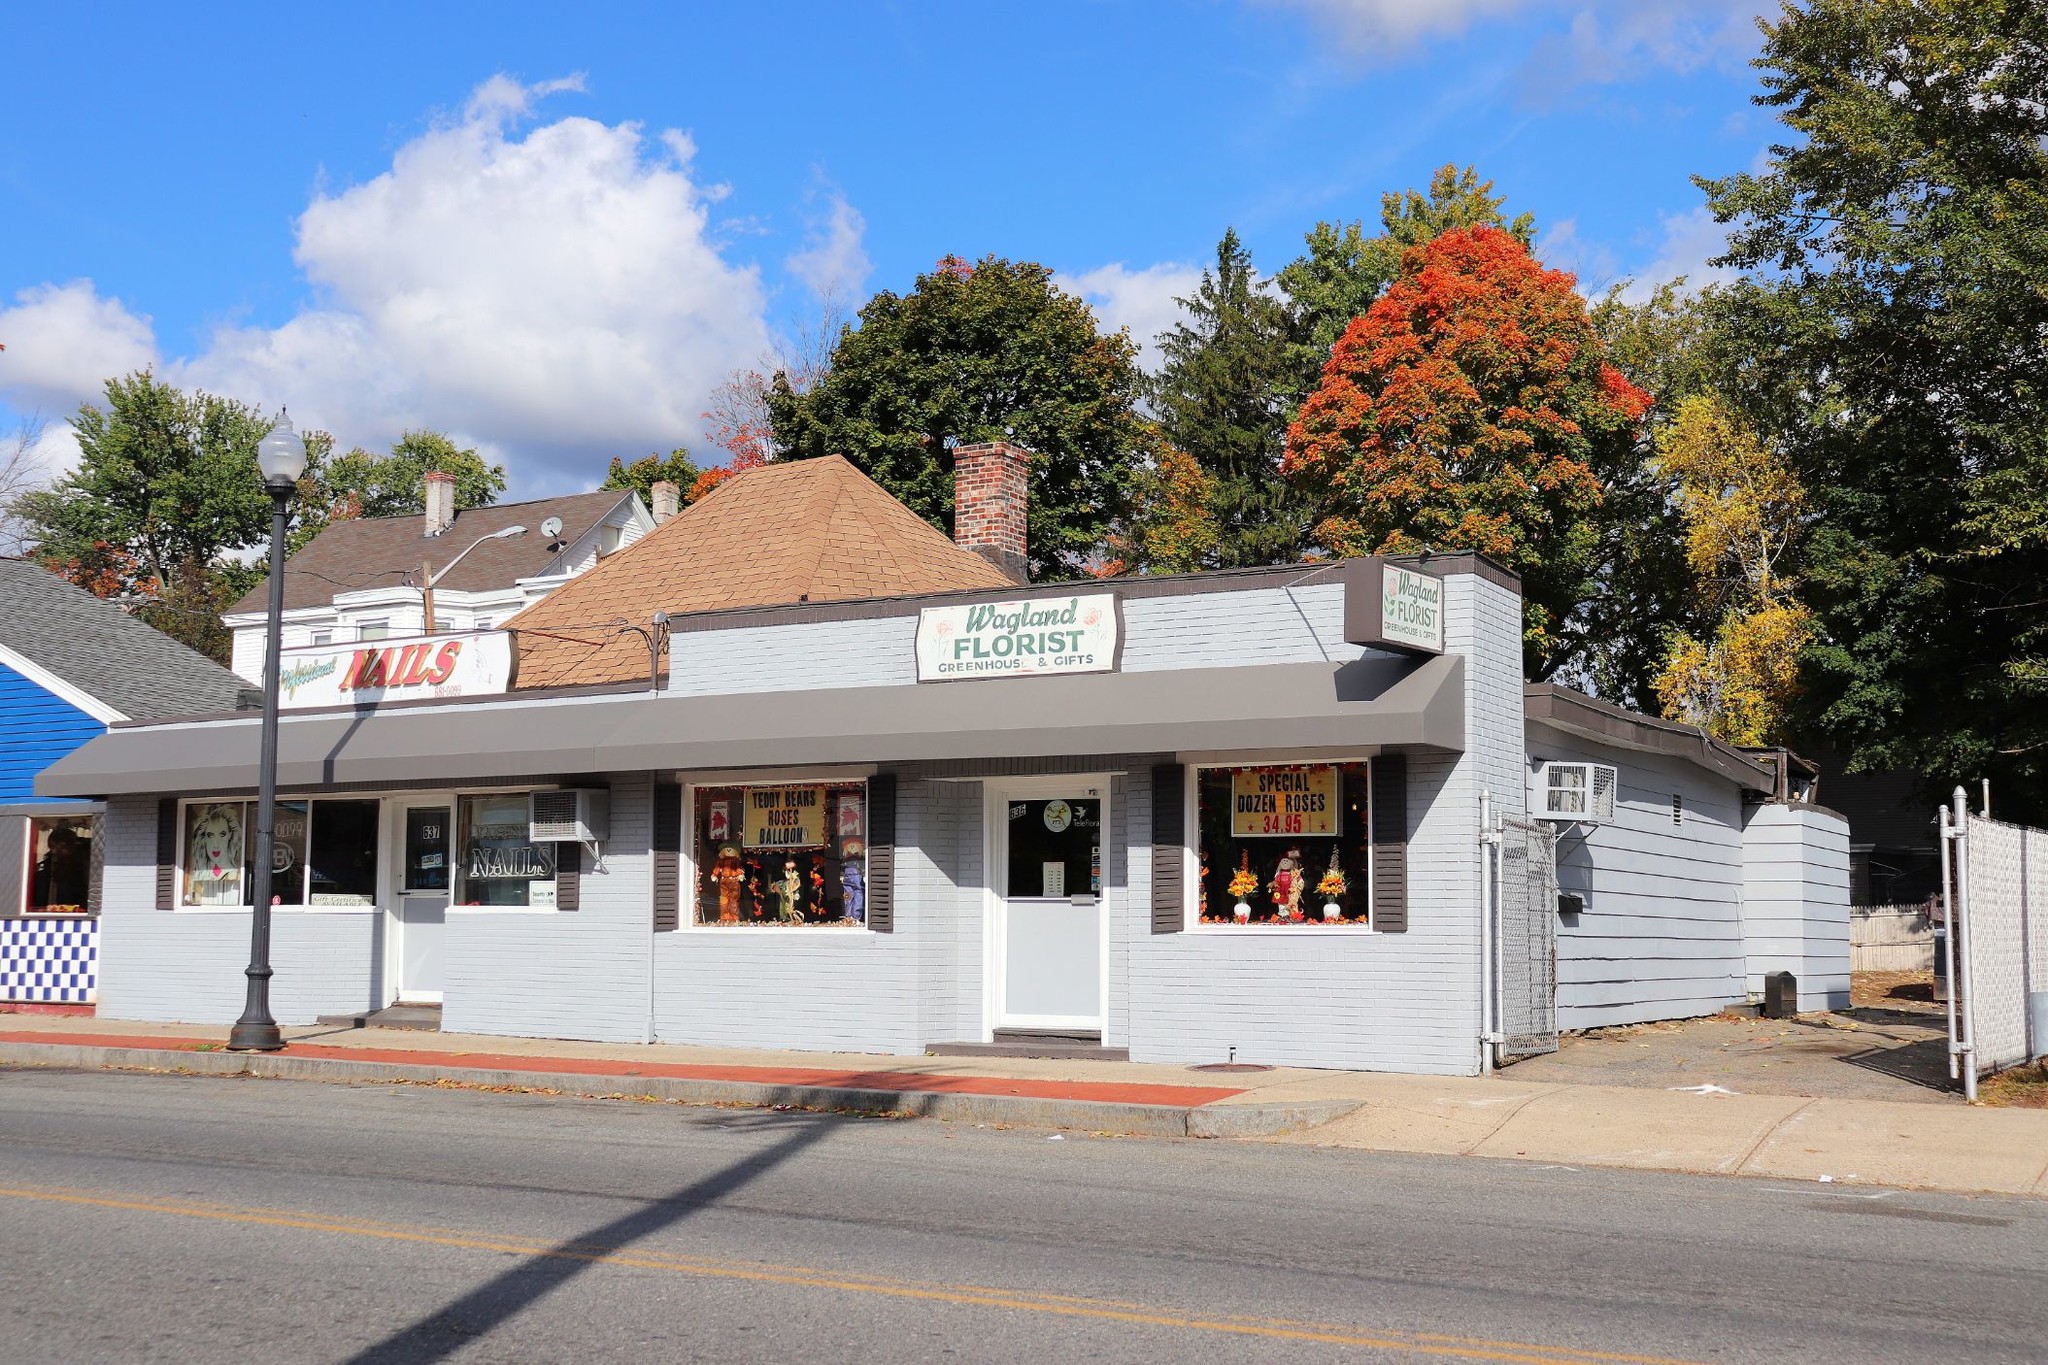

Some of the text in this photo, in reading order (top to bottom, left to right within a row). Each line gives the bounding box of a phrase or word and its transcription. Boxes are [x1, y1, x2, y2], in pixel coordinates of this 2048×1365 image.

[1399, 571, 1438, 604] Wagland
[966, 598, 1078, 636] Wagland
[1398, 600, 1437, 629] FLORIST
[954, 630, 1084, 659] FLORIST
[338, 641, 463, 692] NAILS
[938, 654, 1093, 673] GREENHOUS & GIFTS
[1259, 773, 1310, 792] SPECIAL
[752, 790, 816, 809] TEDDY BEARS
[1237, 793, 1325, 813] DOZEN ROSES
[768, 809, 799, 826] ROSES
[1263, 814, 1302, 833] 34.95
[423, 826, 439, 839] 637
[470, 847, 553, 878] NAILS
